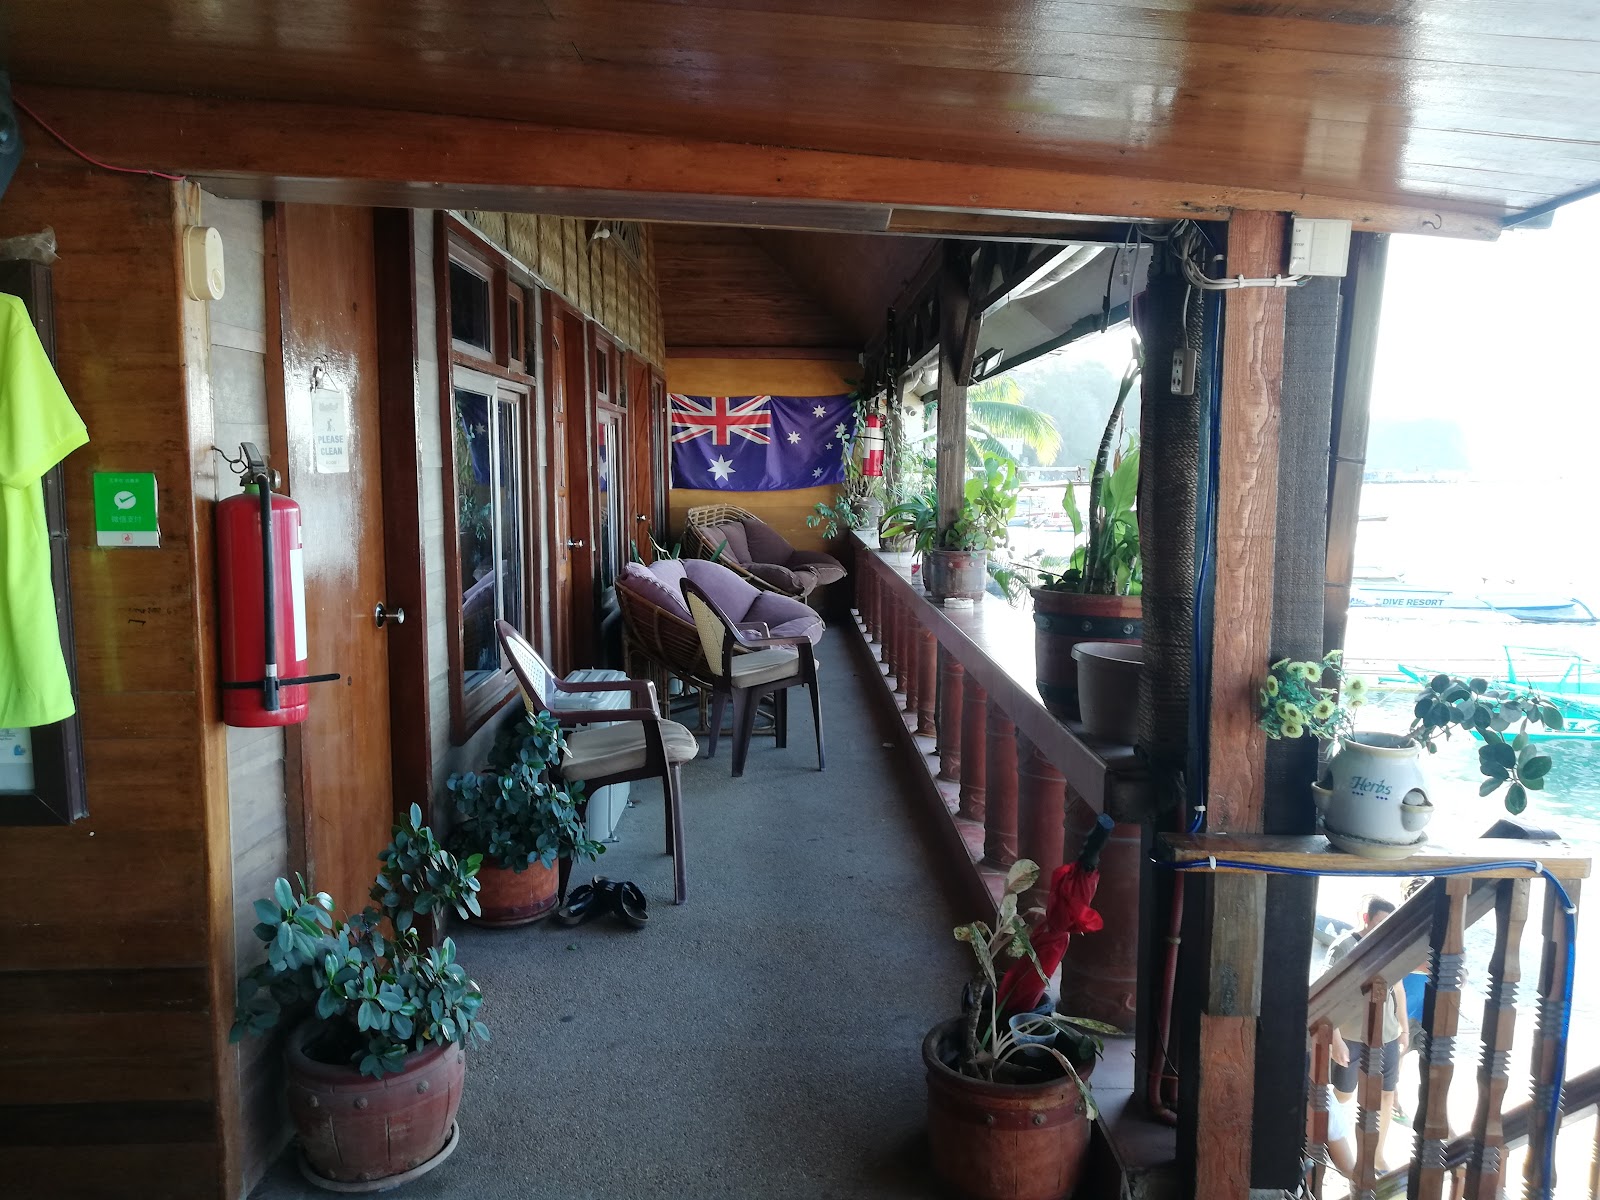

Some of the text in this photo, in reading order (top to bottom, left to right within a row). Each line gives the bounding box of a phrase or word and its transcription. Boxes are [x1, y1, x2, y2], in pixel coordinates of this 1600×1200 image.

[318, 435, 344, 444] PLEASE
[320, 447, 343, 456] CLEAN
[1406, 598, 1445, 606] RESORT
[1351, 776, 1393, 795] Herbs
